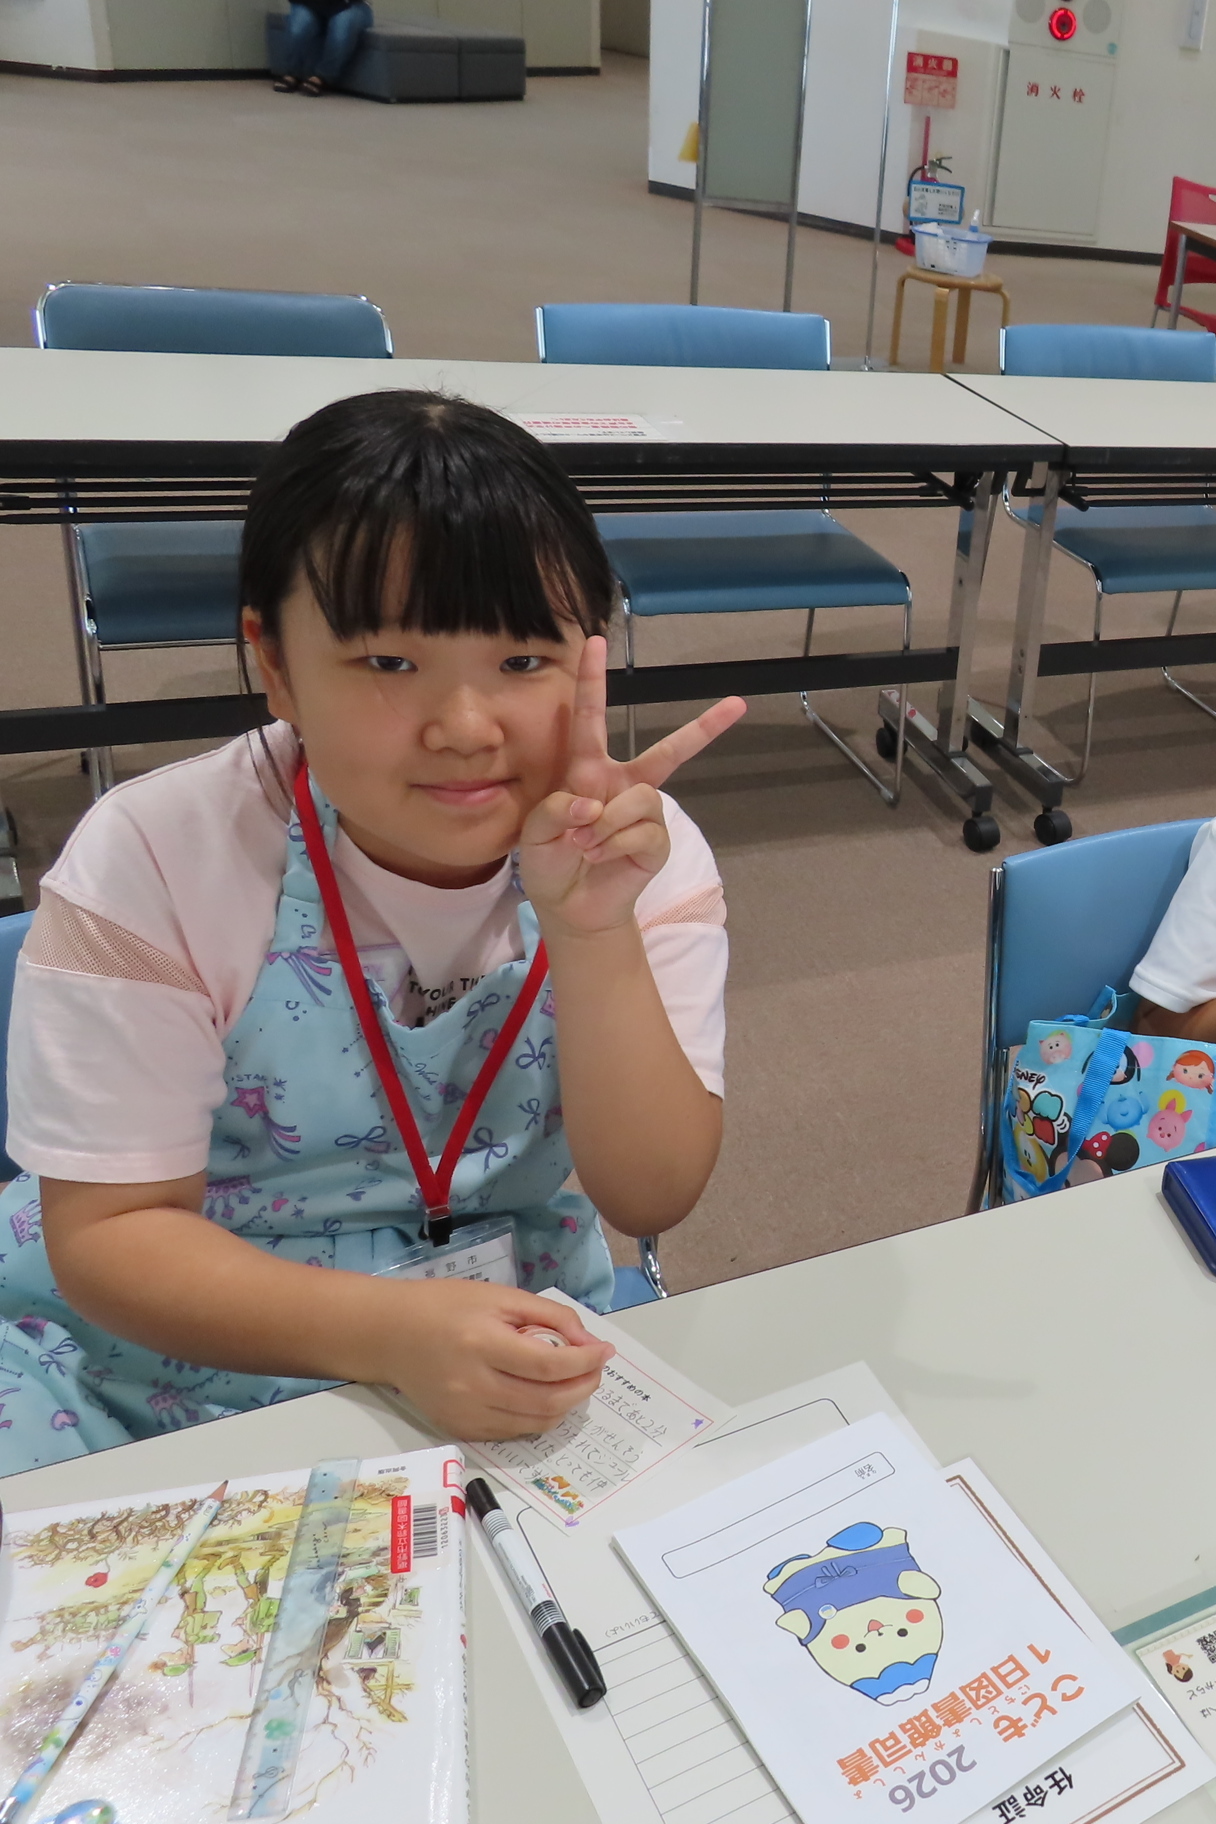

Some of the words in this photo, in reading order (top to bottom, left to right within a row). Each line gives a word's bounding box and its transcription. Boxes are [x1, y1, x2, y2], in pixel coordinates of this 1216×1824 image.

[1026, 81, 1086, 104] 消火栓
[854, 1461, 874, 1478] 名前
[834, 1637, 1054, 1789] 1日図書館司書
[990, 1669, 1087, 1746] こども
[886, 1744, 978, 1813] 2026
[990, 1763, 1078, 1824] 任命証
